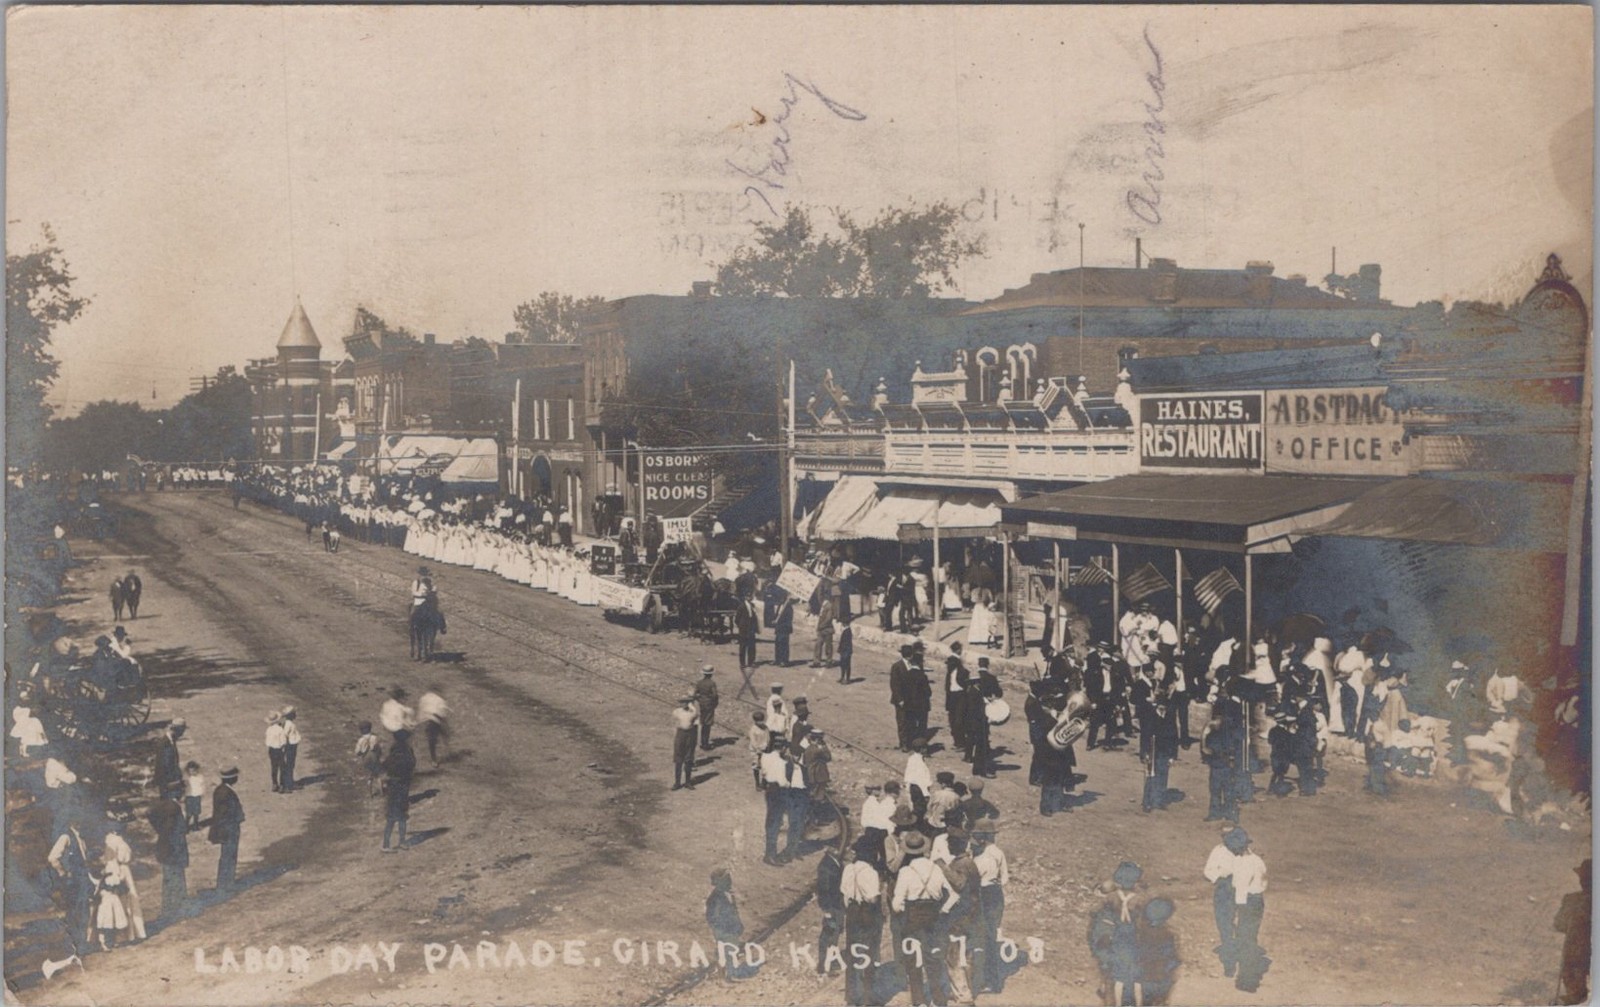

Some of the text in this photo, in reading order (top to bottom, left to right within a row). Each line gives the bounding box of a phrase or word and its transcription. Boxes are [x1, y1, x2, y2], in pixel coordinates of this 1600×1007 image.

[1142, 422, 1261, 460] RESTAURANT
[1291, 437, 1382, 461] OFFICE
[645, 472, 709, 483] NICE CLEA
[645, 484, 709, 501] ROOMS
